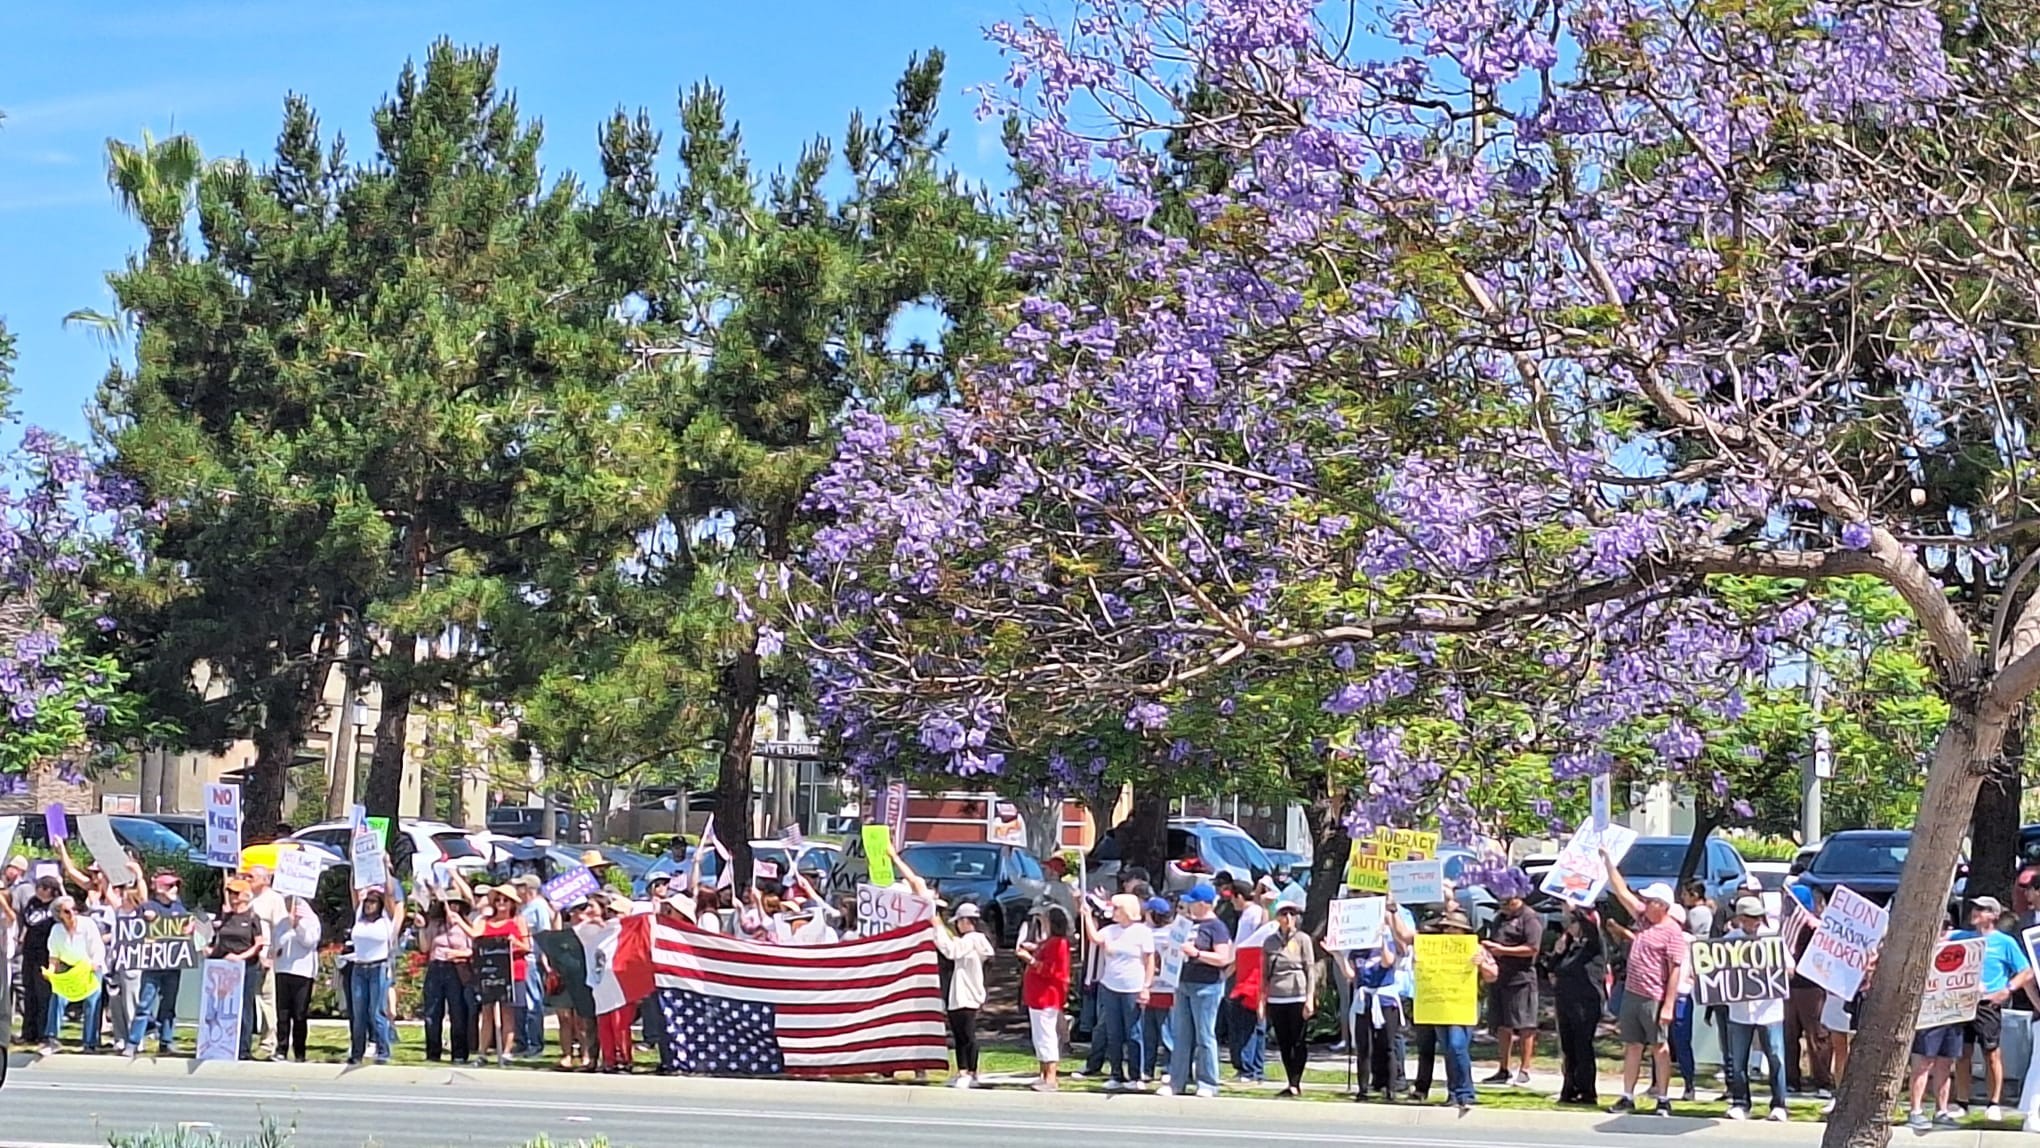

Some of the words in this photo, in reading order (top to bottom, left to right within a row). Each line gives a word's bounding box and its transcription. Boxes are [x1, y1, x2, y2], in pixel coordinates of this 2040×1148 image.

[213, 788, 232, 805] NO
[1384, 845, 1401, 859] VS
[1831, 889, 1881, 929] ELON
[119, 917, 147, 941] NO
[115, 941, 193, 971] AMERICA
[1692, 938, 1783, 975] BOYCOTT
[1814, 931, 1869, 971] CHILDREN
[1699, 967, 1788, 1003] MUSK
